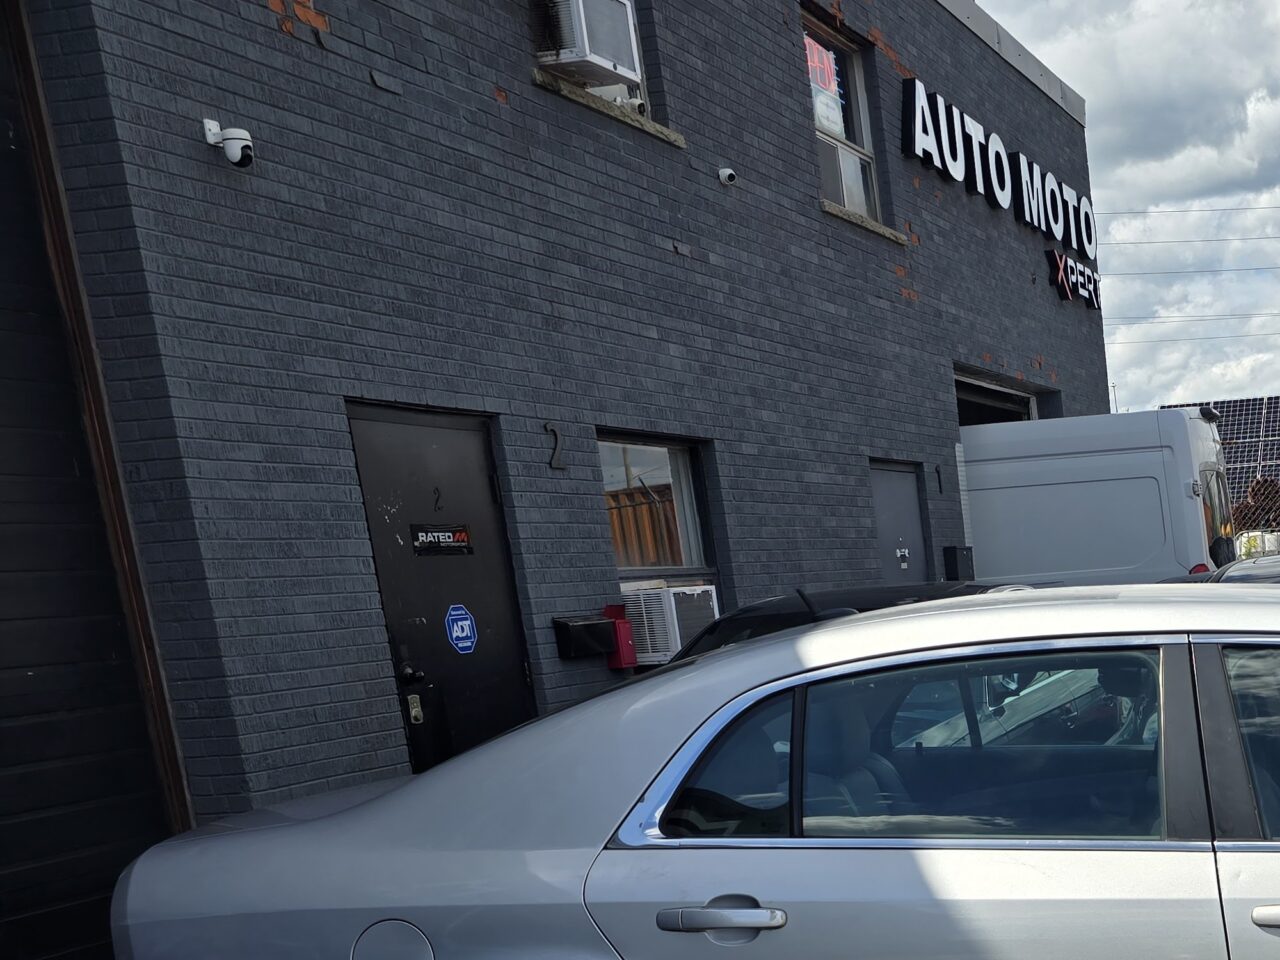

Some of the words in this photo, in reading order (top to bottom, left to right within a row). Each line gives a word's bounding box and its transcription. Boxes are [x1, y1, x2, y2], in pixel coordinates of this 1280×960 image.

[914, 79, 1012, 210] AUTO
[1019, 152, 1098, 260] MOTO
[543, 421, 567, 471] 2
[418, 532, 453, 542] RATED
[453, 620, 470, 638] ADT
